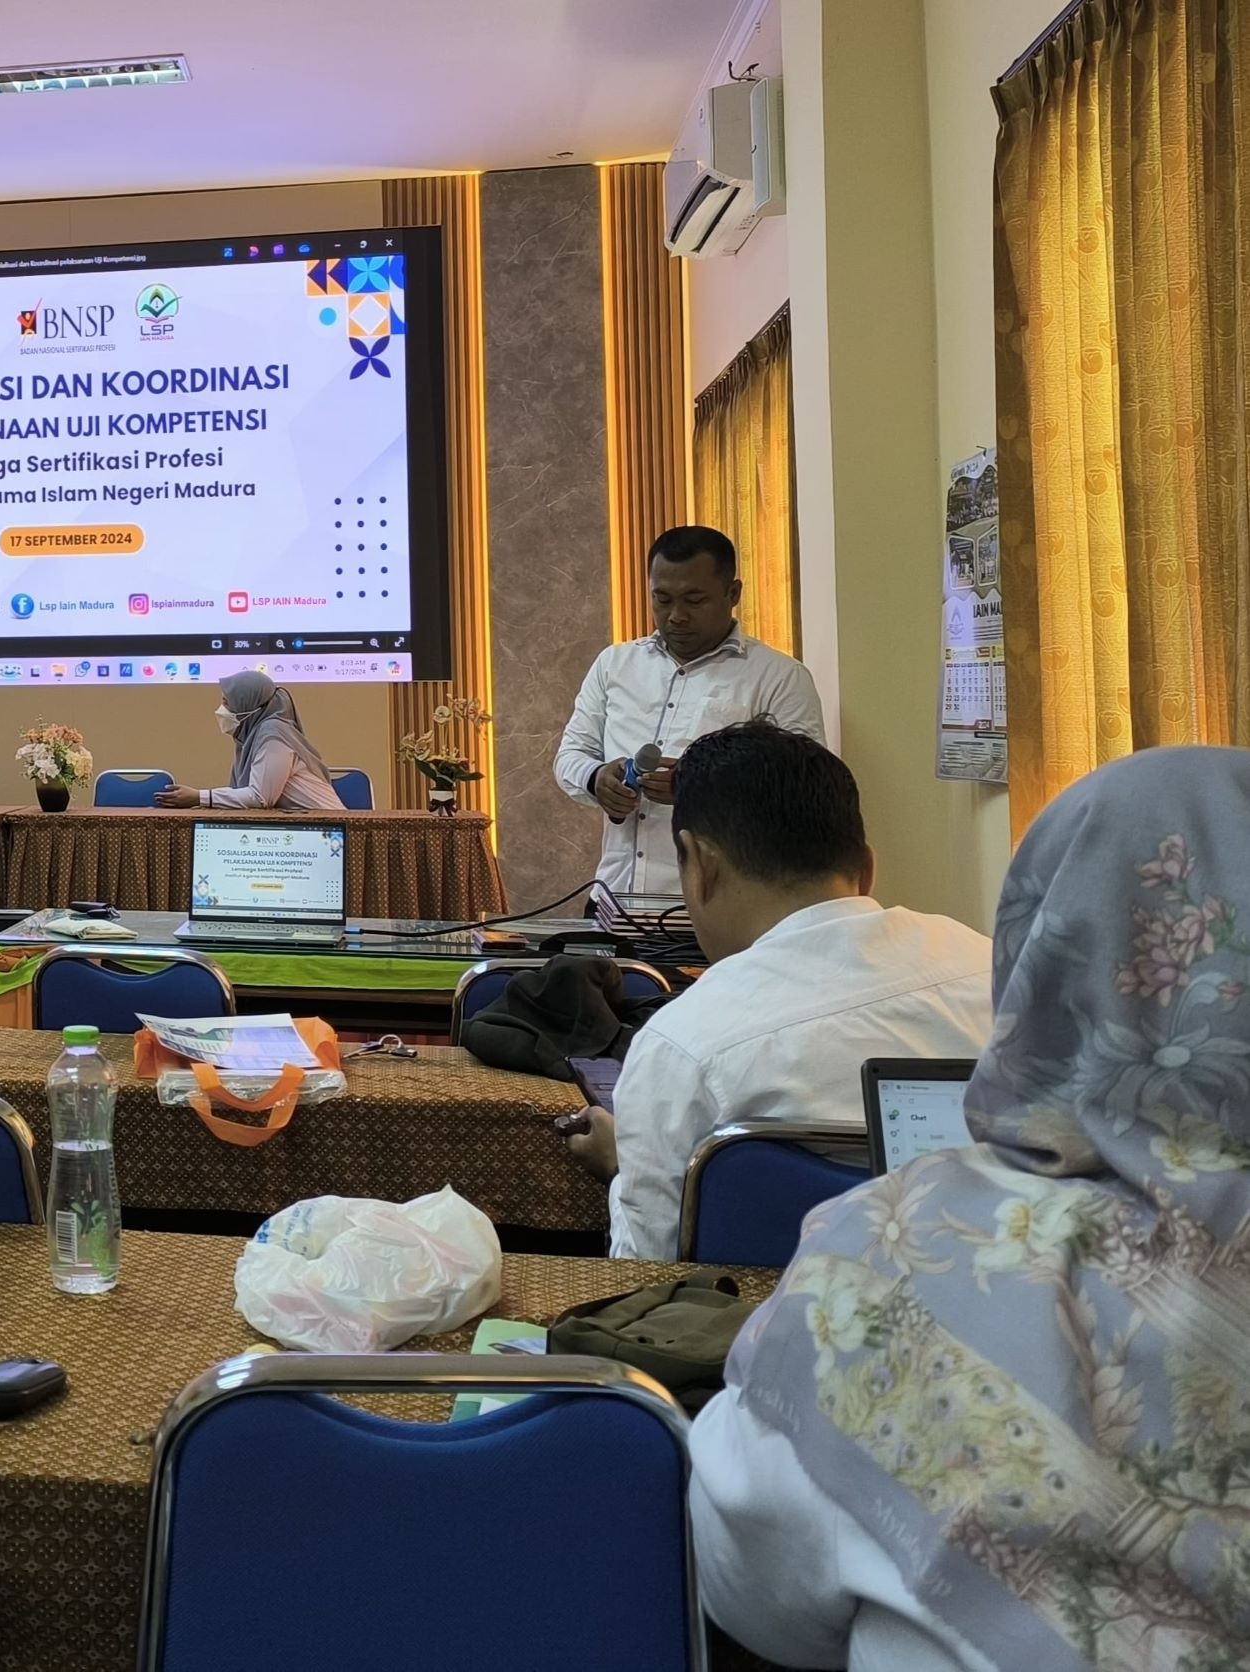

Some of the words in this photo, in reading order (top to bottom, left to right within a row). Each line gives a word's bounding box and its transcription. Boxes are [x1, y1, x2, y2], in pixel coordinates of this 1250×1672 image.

[43, 305, 115, 339] BNSP
[140, 324, 174, 336] LSP
[20, 347, 38, 355] BADAN
[39, 346, 65, 354] NASIONAL
[32, 373, 92, 399] DAN
[102, 364, 288, 396] KOORDINASI
[67, 416, 100, 437] UJI
[109, 409, 266, 436] KOMPETENSI
[27, 450, 139, 472] Sertifikasi
[146, 447, 222, 468] Profesi
[42, 486, 97, 502] Islam
[103, 481, 168, 505] Negeri
[175, 481, 255, 498] Madura
[10, 536, 22, 547] 17
[25, 534, 97, 546] SEPTEMBER
[101, 533, 132, 544] 2024
[39, 600, 56, 612] Lsp
[79, 599, 114, 610] Madura
[151, 599, 215, 610] lspiainmadura
[252, 597, 270, 606] LSP
[272, 597, 291, 606] IAIN
[293, 596, 327, 606] Madura
[973, 603, 989, 619] IAIN
[234, 640, 250, 648] 30%
[217, 849, 258, 857] SOSIALISASI
